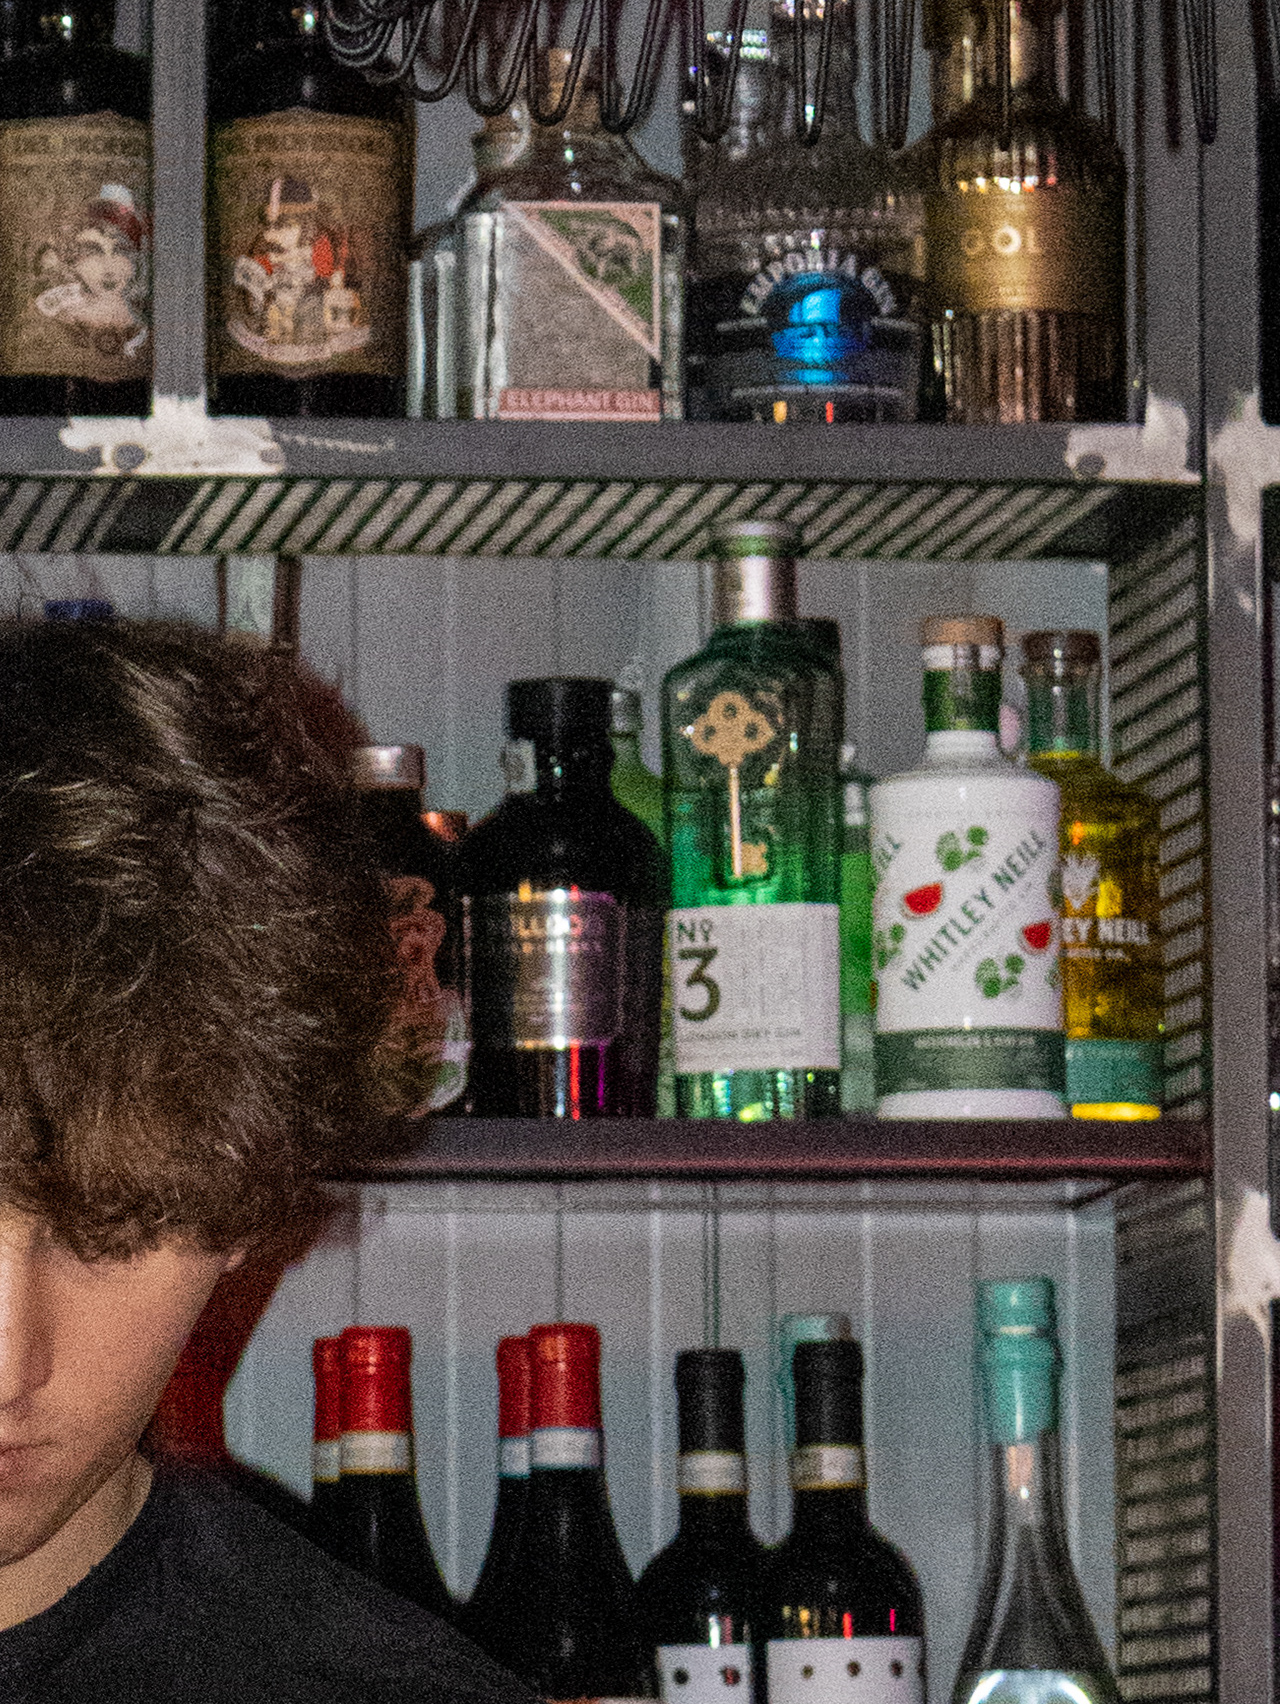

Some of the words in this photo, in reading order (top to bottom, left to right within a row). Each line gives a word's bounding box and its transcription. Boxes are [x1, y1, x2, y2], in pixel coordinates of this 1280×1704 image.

[900, 885, 996, 992] WHITLEY
[990, 829, 1045, 893] NEILL
[677, 946, 722, 1023] 3
